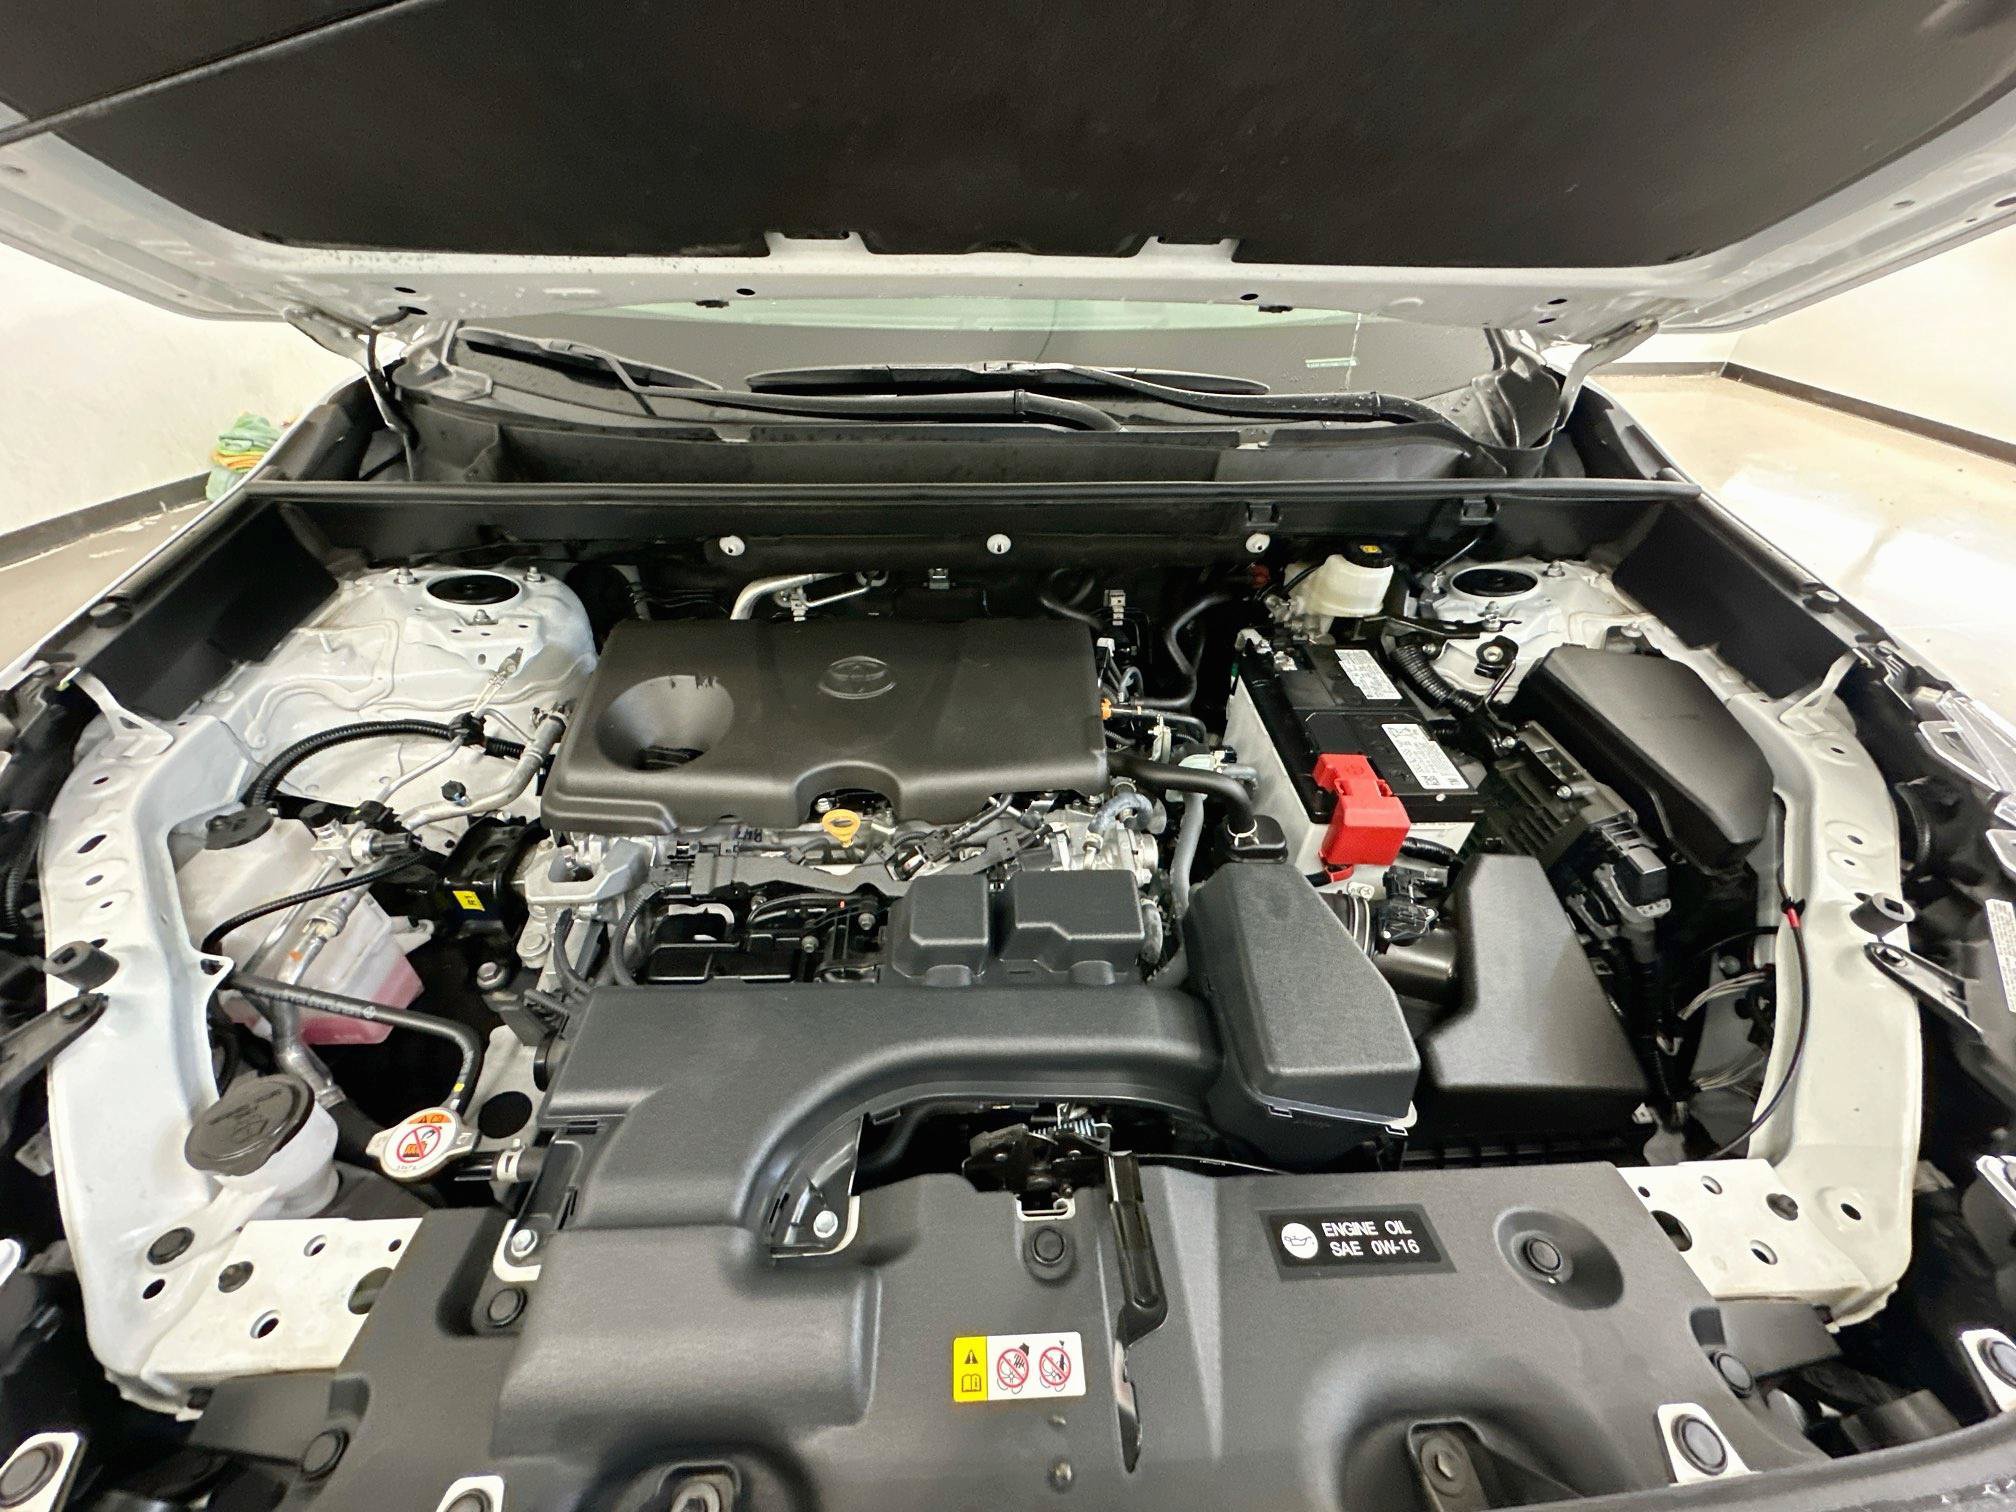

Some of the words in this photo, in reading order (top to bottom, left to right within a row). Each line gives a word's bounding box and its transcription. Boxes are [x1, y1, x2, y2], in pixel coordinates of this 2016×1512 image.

[1321, 1221, 1378, 1237] ENGINE
[1384, 1220, 1412, 1235] OIL
[1330, 1241, 1364, 1257] SAE
[1371, 1239, 1420, 1256] 0W-16
